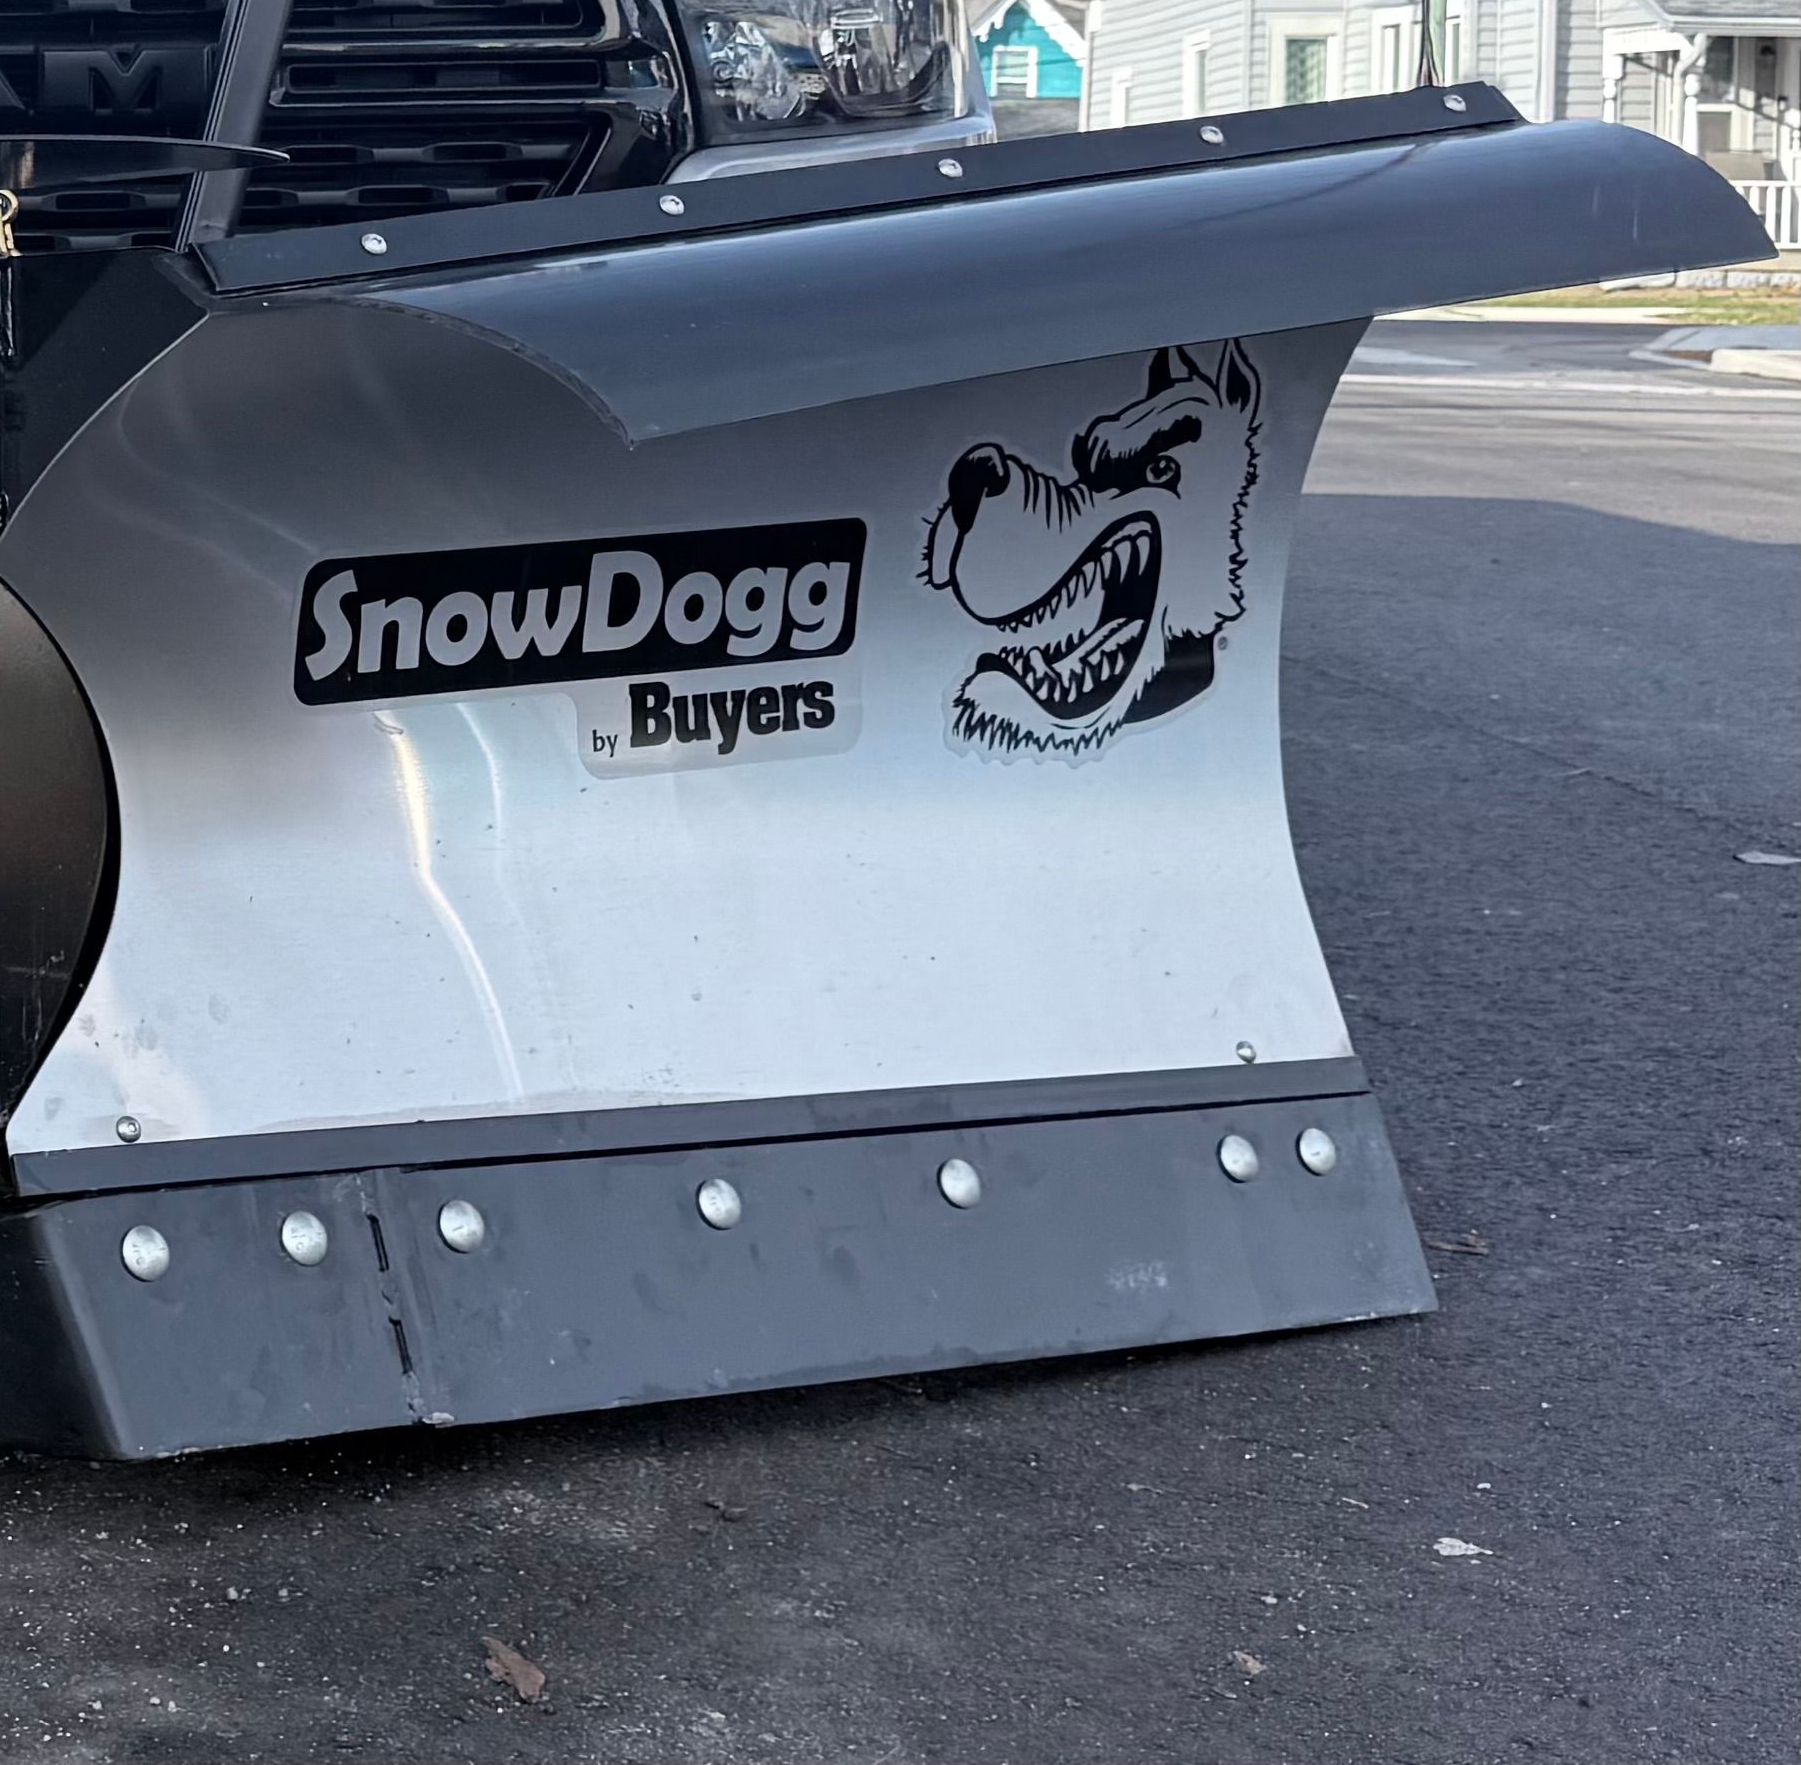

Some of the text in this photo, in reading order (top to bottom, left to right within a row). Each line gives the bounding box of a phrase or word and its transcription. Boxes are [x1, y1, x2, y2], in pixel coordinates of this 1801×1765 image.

[304, 550, 851, 682] SnowDogg
[592, 681, 835, 757] by Buyers
